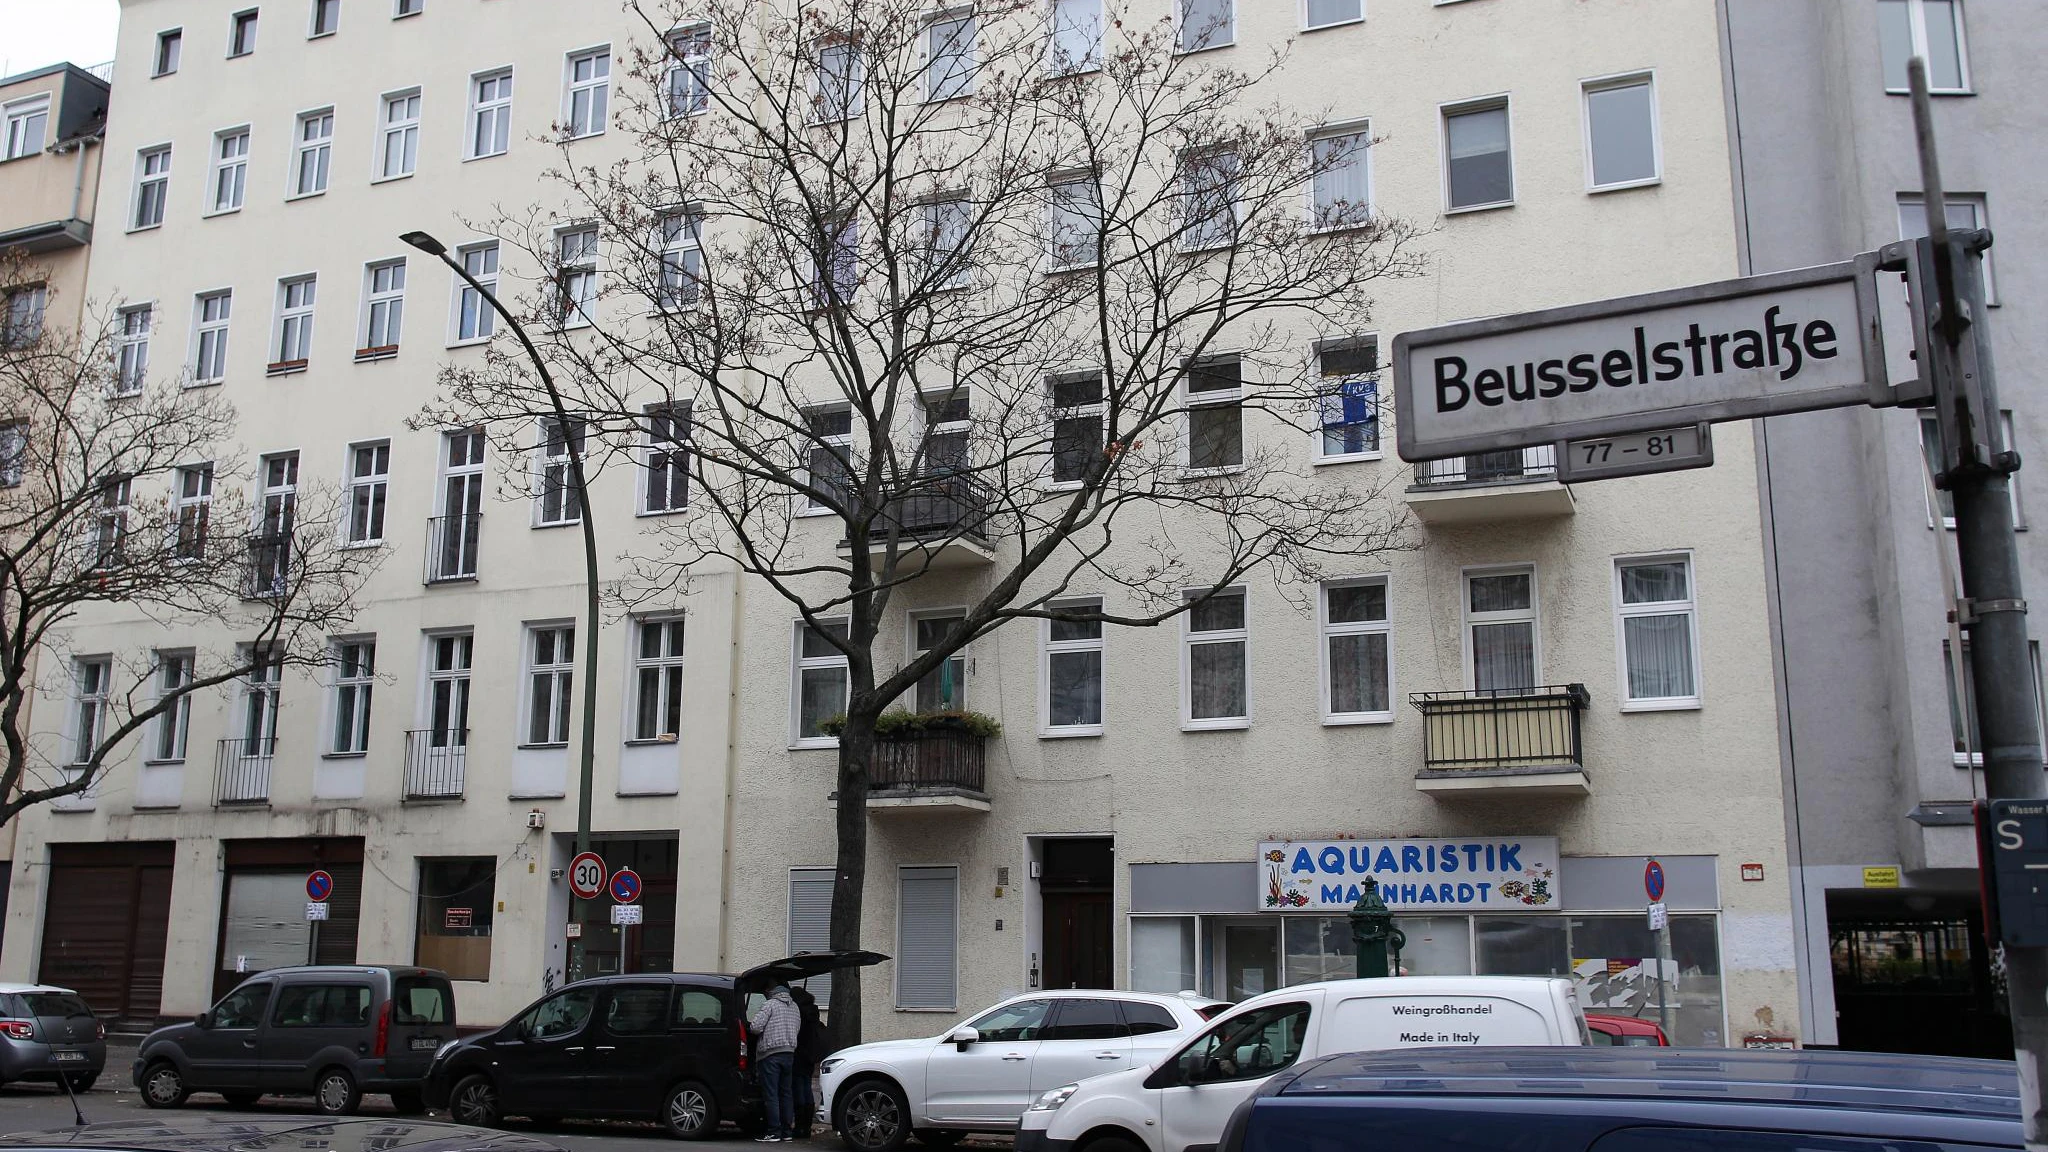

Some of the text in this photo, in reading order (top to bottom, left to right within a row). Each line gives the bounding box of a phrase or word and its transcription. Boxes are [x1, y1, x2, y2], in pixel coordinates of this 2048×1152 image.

[1433, 305, 1839, 414] Beusselstraße
[1581, 442, 1611, 464] 77
[1646, 434, 1675, 457] 81
[2008, 805, 2043, 814] Wasser
[1996, 819, 2023, 850] S
[1290, 843, 1522, 875] AQUARISTIK
[577, 865, 599, 886] 30
[1392, 1004, 1492, 1018] Weingroßhandel
[1400, 1032, 1480, 1045] Made in Italy
